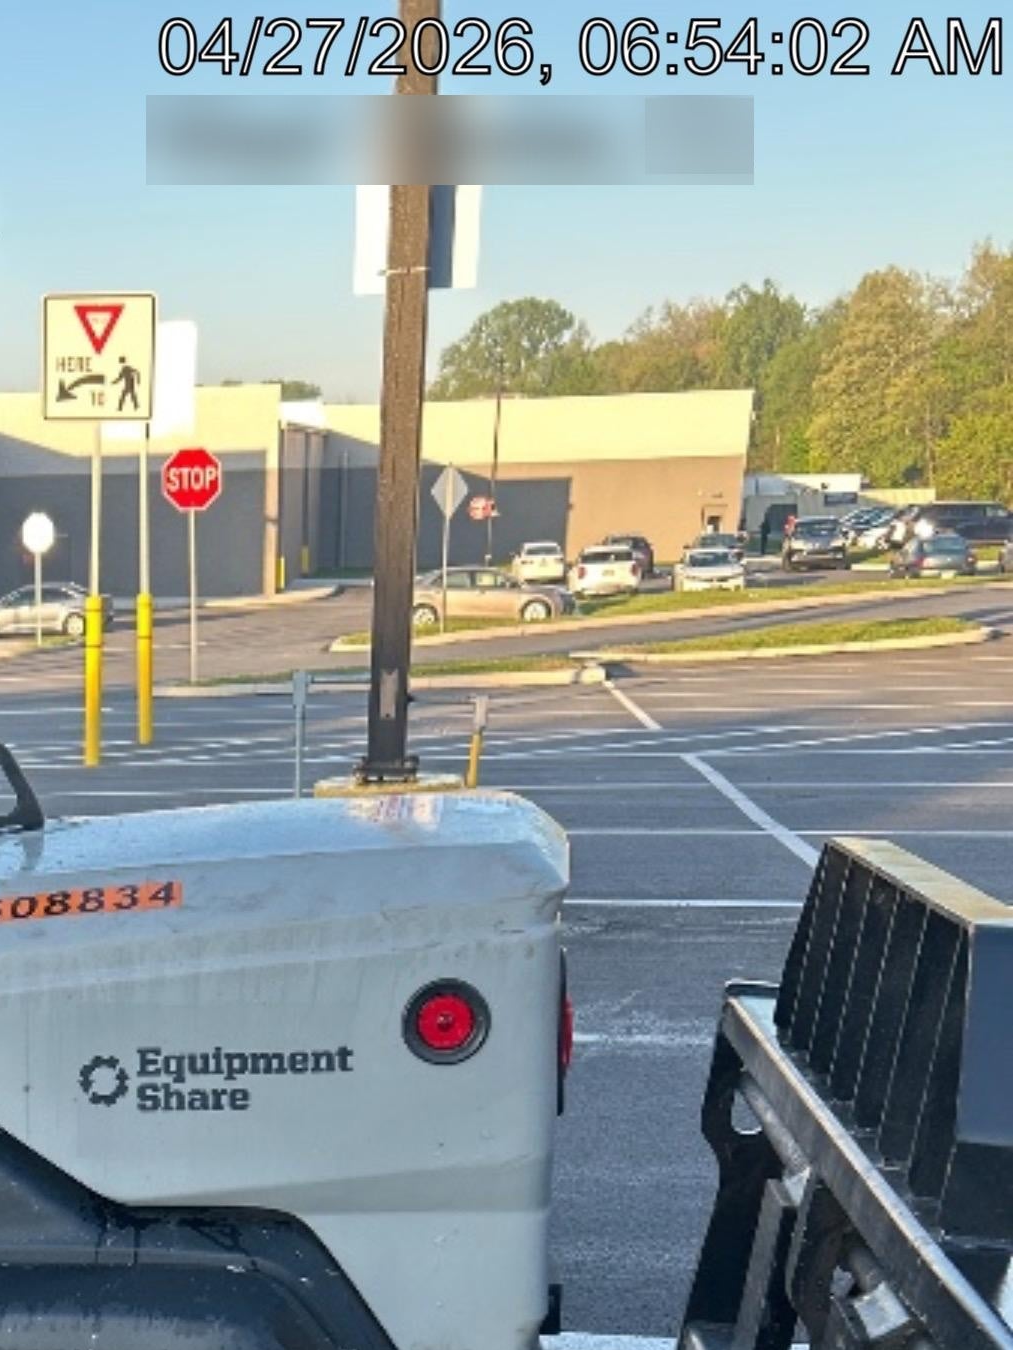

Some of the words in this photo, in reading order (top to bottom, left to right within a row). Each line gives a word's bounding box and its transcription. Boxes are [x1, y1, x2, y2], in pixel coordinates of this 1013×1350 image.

[55, 356, 93, 373] HERE
[166, 466, 218, 491] STOP
[136, 1045, 354, 1085] Equipment
[136, 1083, 251, 1112] Share
